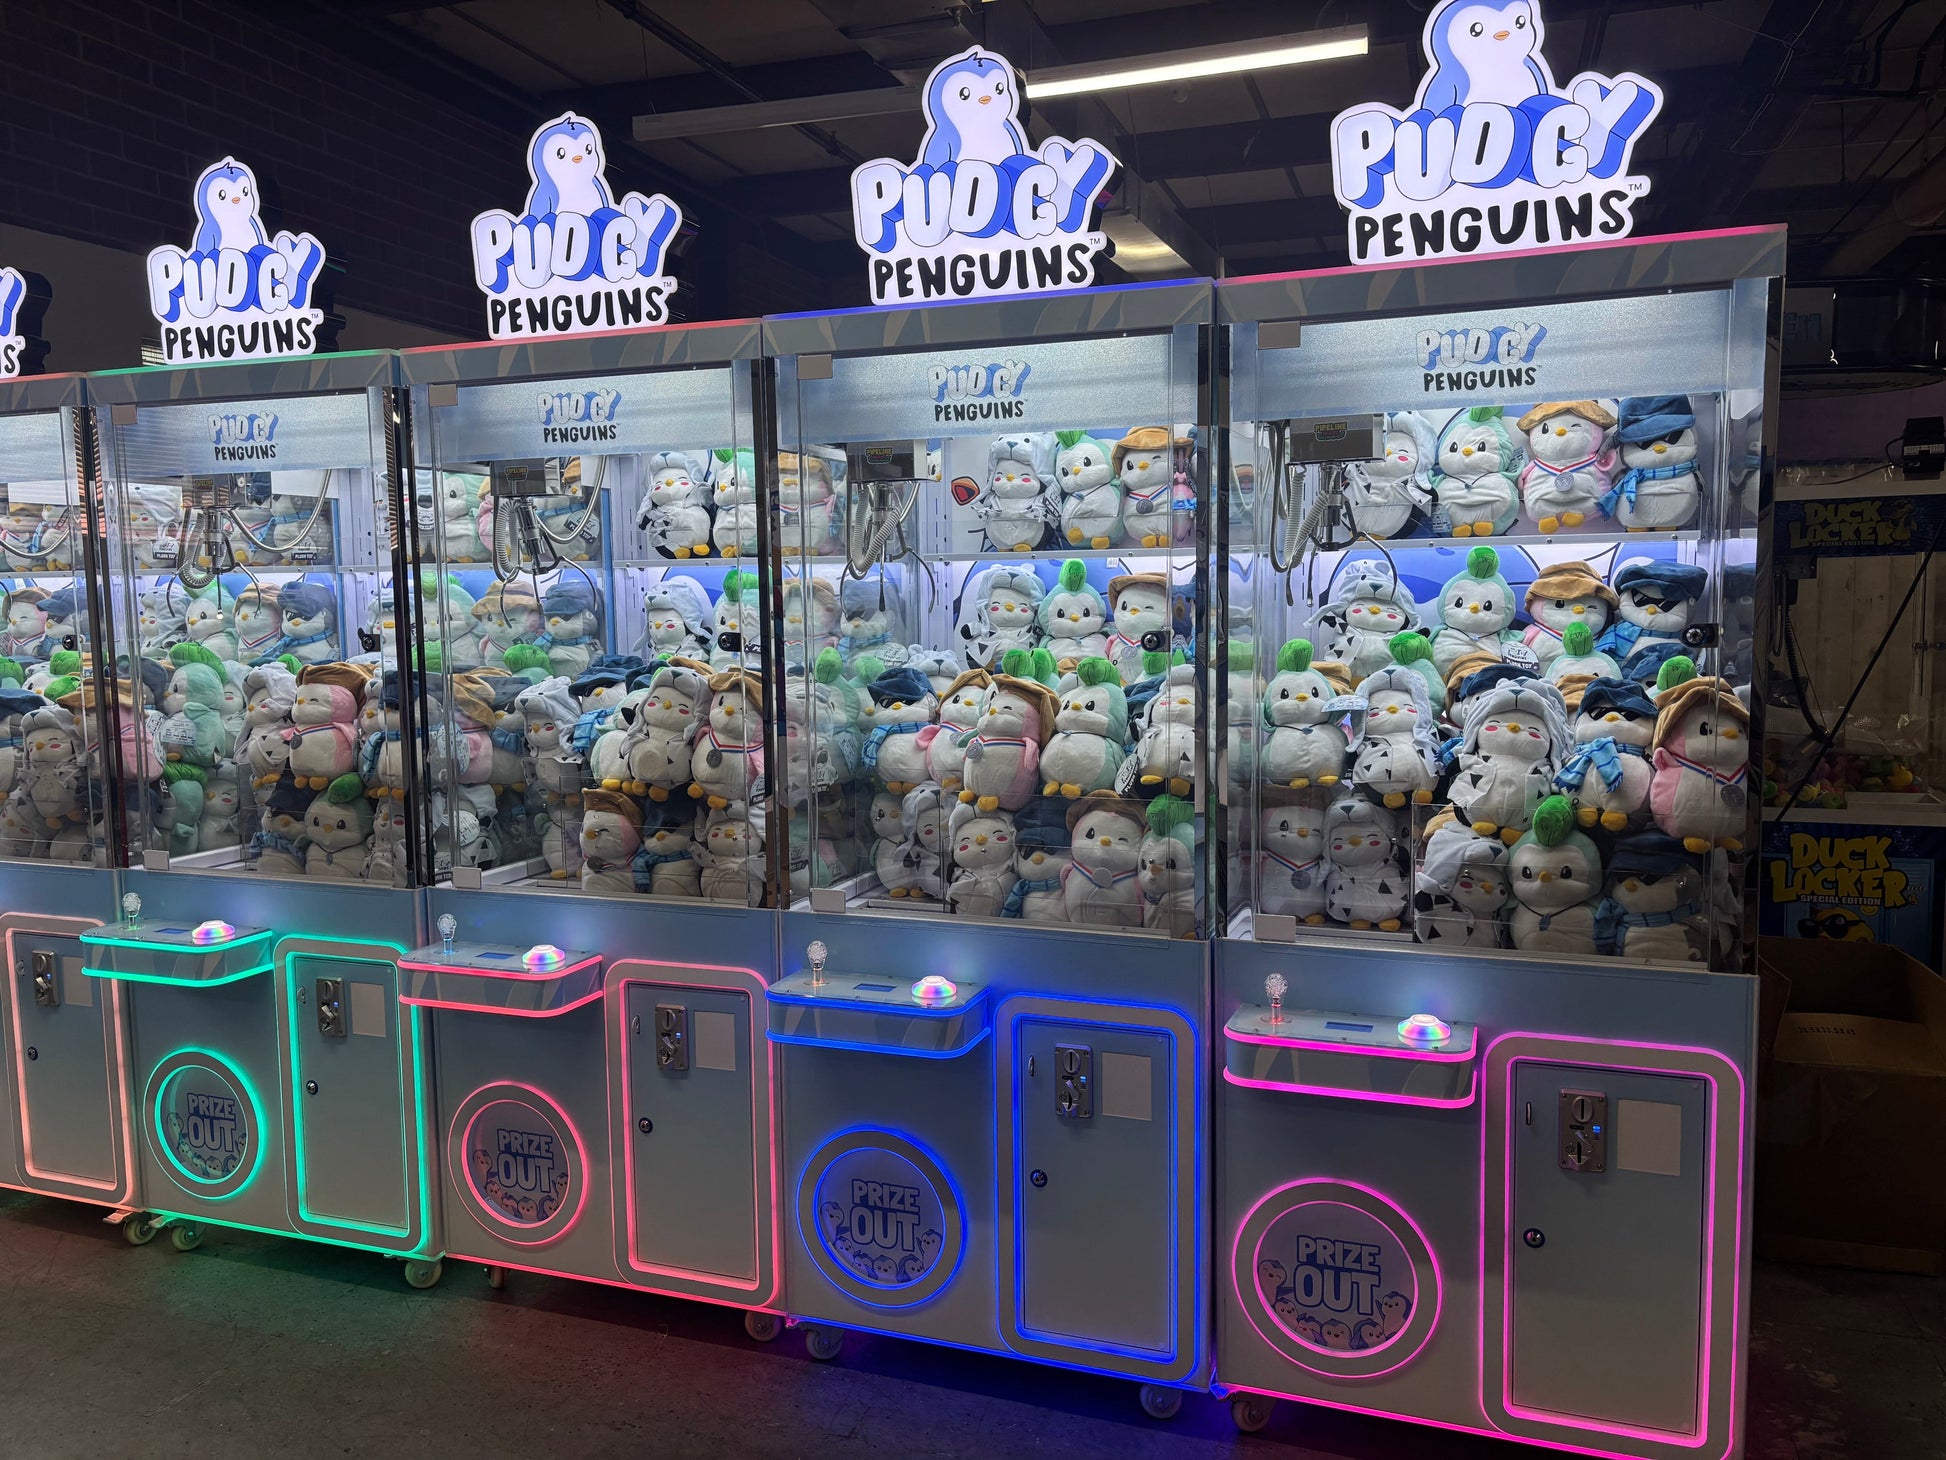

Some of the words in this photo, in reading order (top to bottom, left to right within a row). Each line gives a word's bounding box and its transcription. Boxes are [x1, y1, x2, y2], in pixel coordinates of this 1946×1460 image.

[1337, 78, 1655, 210] PUDGY
[855, 141, 1113, 254] PUDGY
[1355, 188, 1629, 260] PENGUINS
[474, 196, 677, 294] PUDGY
[150, 235, 322, 323] PUDGY
[874, 242, 1089, 300] PENGUINS
[490, 285, 663, 334] PENGUINS
[165, 317, 313, 362] PENGUINS
[1416, 320, 1547, 371] PUDGY
[927, 359, 1031, 403] PUDGY
[1423, 367, 1537, 392] PENGUINS
[537, 387, 621, 426] PUDGY
[934, 400, 1025, 422] PENGUINS
[207, 410, 279, 445] PUDGY
[543, 424, 617, 443] PENGUINS
[214, 444, 277, 461] PENGUINS
[1804, 500, 1882, 525] DUCK
[1789, 520, 1895, 550] LOCKER
[1790, 832, 1892, 869] DUCK
[1770, 859, 1907, 909] LOCKER
[1800, 893, 1840, 904] SPECIAL
[1841, 896, 1881, 906] EDITION
[187, 1092, 236, 1120] PRIZE
[186, 1114, 236, 1152] OUT
[496, 1128, 553, 1158] PRIZE
[496, 1152, 554, 1193] OUT
[851, 1178, 920, 1212] PRIZE
[850, 1206, 920, 1252] OUT
[1297, 1235, 1381, 1272] PRIZE
[1294, 1264, 1381, 1316] OUT
